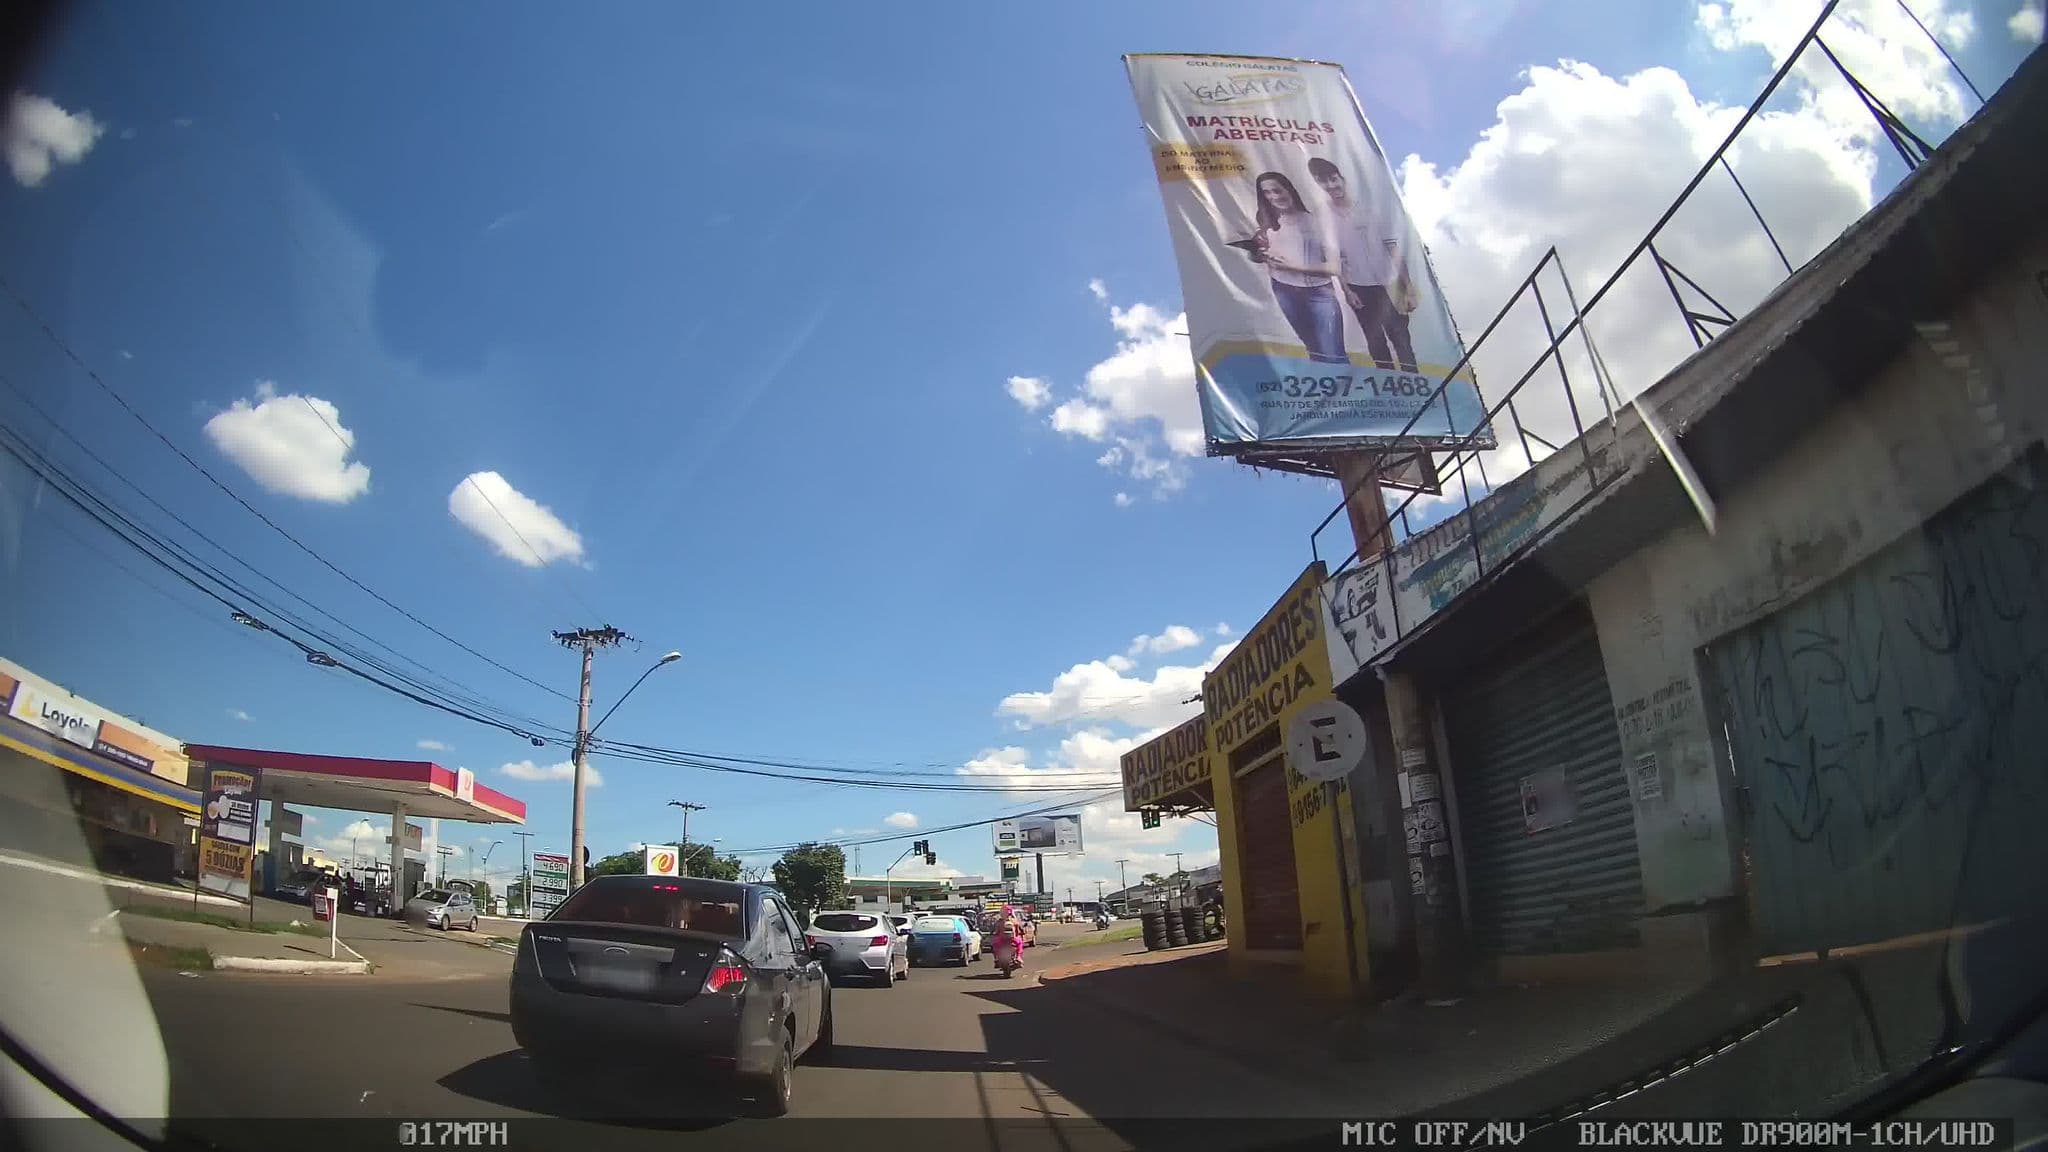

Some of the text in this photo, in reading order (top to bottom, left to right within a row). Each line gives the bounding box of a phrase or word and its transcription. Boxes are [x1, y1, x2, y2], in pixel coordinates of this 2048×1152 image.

[1186, 115, 1335, 134] MATRÍCULAS
[1213, 128, 1324, 145] ABERTAS!
[1283, 375, 1433, 398] 3297-1468
[1207, 588, 1318, 725] RADIADORES
[1215, 661, 1315, 752] POTÊNCIA
[1310, 716, 1342, 762] E
[205, 849, 246, 872] 5 DÚZIAS
